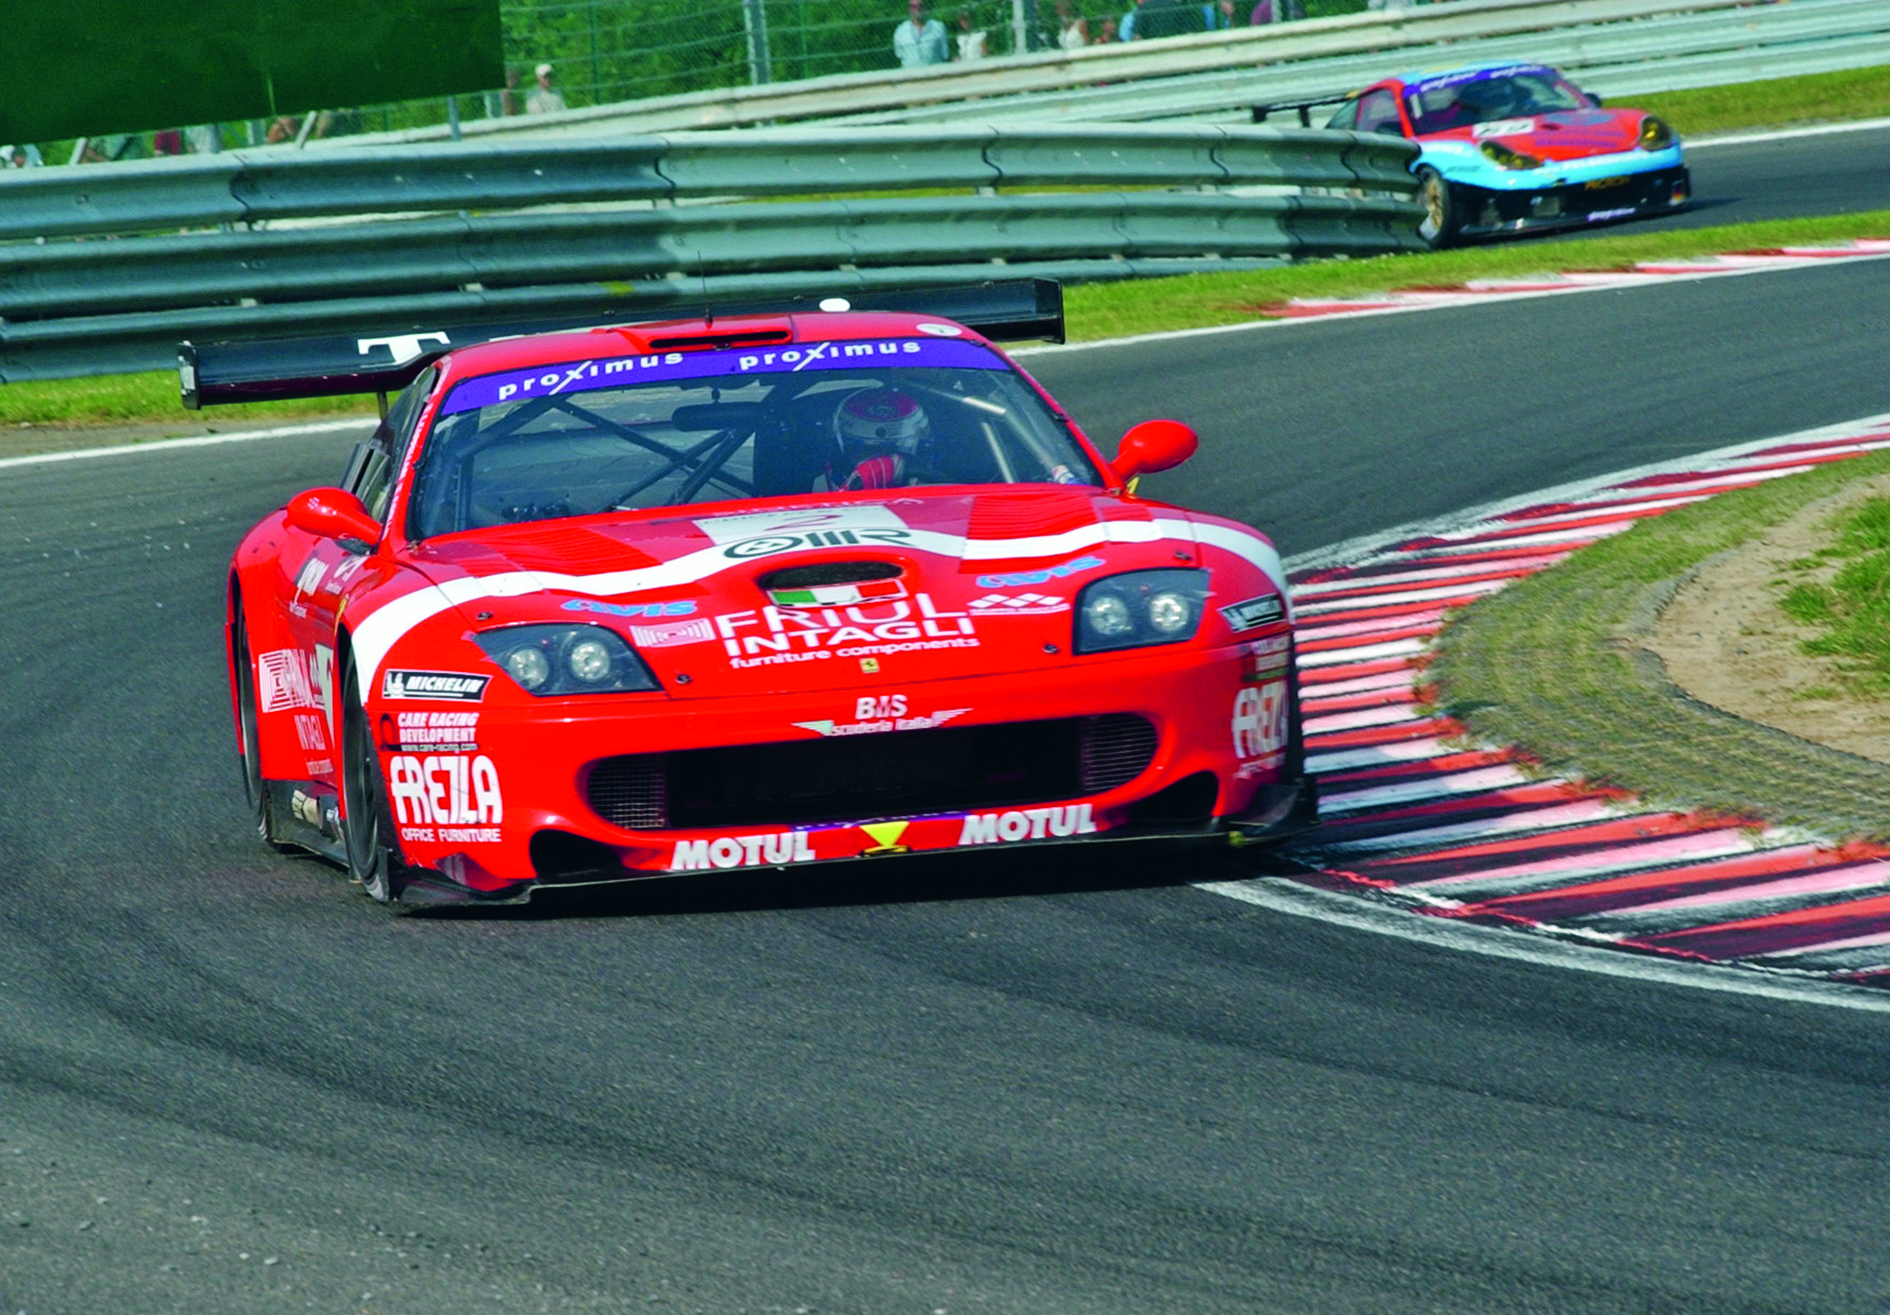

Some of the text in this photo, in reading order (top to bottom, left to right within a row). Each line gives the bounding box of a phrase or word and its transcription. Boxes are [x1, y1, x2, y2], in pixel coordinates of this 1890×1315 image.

[498, 340, 921, 401] proximus proximus
[715, 593, 967, 639] FRIUL
[724, 617, 975, 657] INTAGLI
[729, 636, 980, 669] furniture components
[405, 675, 485, 693] MICHELIN
[399, 727, 477, 743] DEVELOPMENT
[428, 712, 480, 727] RACING
[401, 828, 502, 842] OFFICE FURNITURE
[959, 803, 1098, 846] MOTUL
[671, 831, 816, 870] MOTUL
